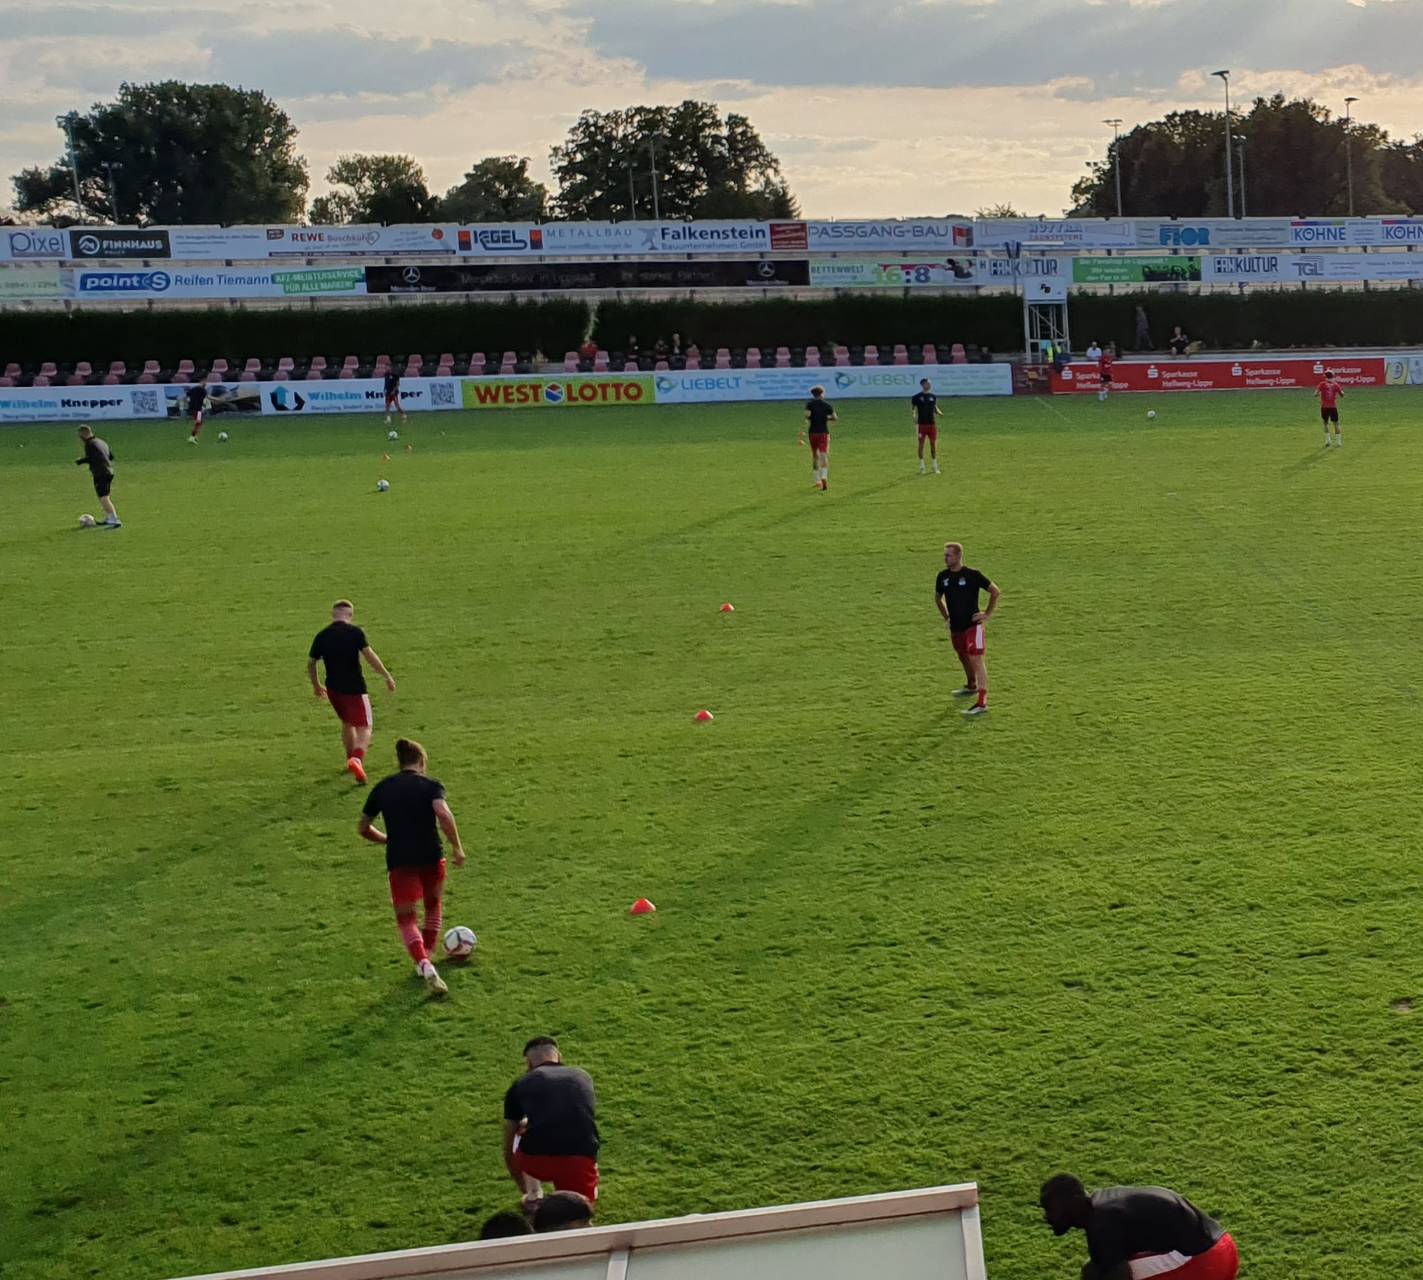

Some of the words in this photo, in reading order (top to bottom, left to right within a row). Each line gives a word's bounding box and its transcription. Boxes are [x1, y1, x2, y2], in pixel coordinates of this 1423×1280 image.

[291, 232, 325, 243] REWE
[661, 226, 766, 241] Falkenstein
[808, 225, 949, 239] PASSGANG-BAU
[9, 232, 65, 253] Pixel
[102, 239, 163, 250] FINNHAUS
[86, 274, 139, 290] point
[151, 272, 167, 288] S
[174, 273, 214, 286] Reifen
[216, 272, 270, 286] Tiemann
[1076, 371, 1101, 381] Sparka
[1161, 370, 1199, 380] Sparkasse
[1245, 368, 1282, 377] Sparkasse
[681, 376, 742, 391] LIEBELT
[858, 373, 917, 387] LIEBELT
[1161, 379, 1214, 389] Hellweg-Lippe
[1245, 377, 1297, 387] Hellweg-Lippe
[1333, 375, 1377, 386] ellweg-Lippe
[307, 390, 362, 402] Wilhelm
[365, 389, 423, 404] Knper
[473, 382, 544, 405] WEST
[565, 381, 644, 404] LOTTO
[0, 398, 57, 410] Wilhelm
[60, 397, 124, 412] Knepper
